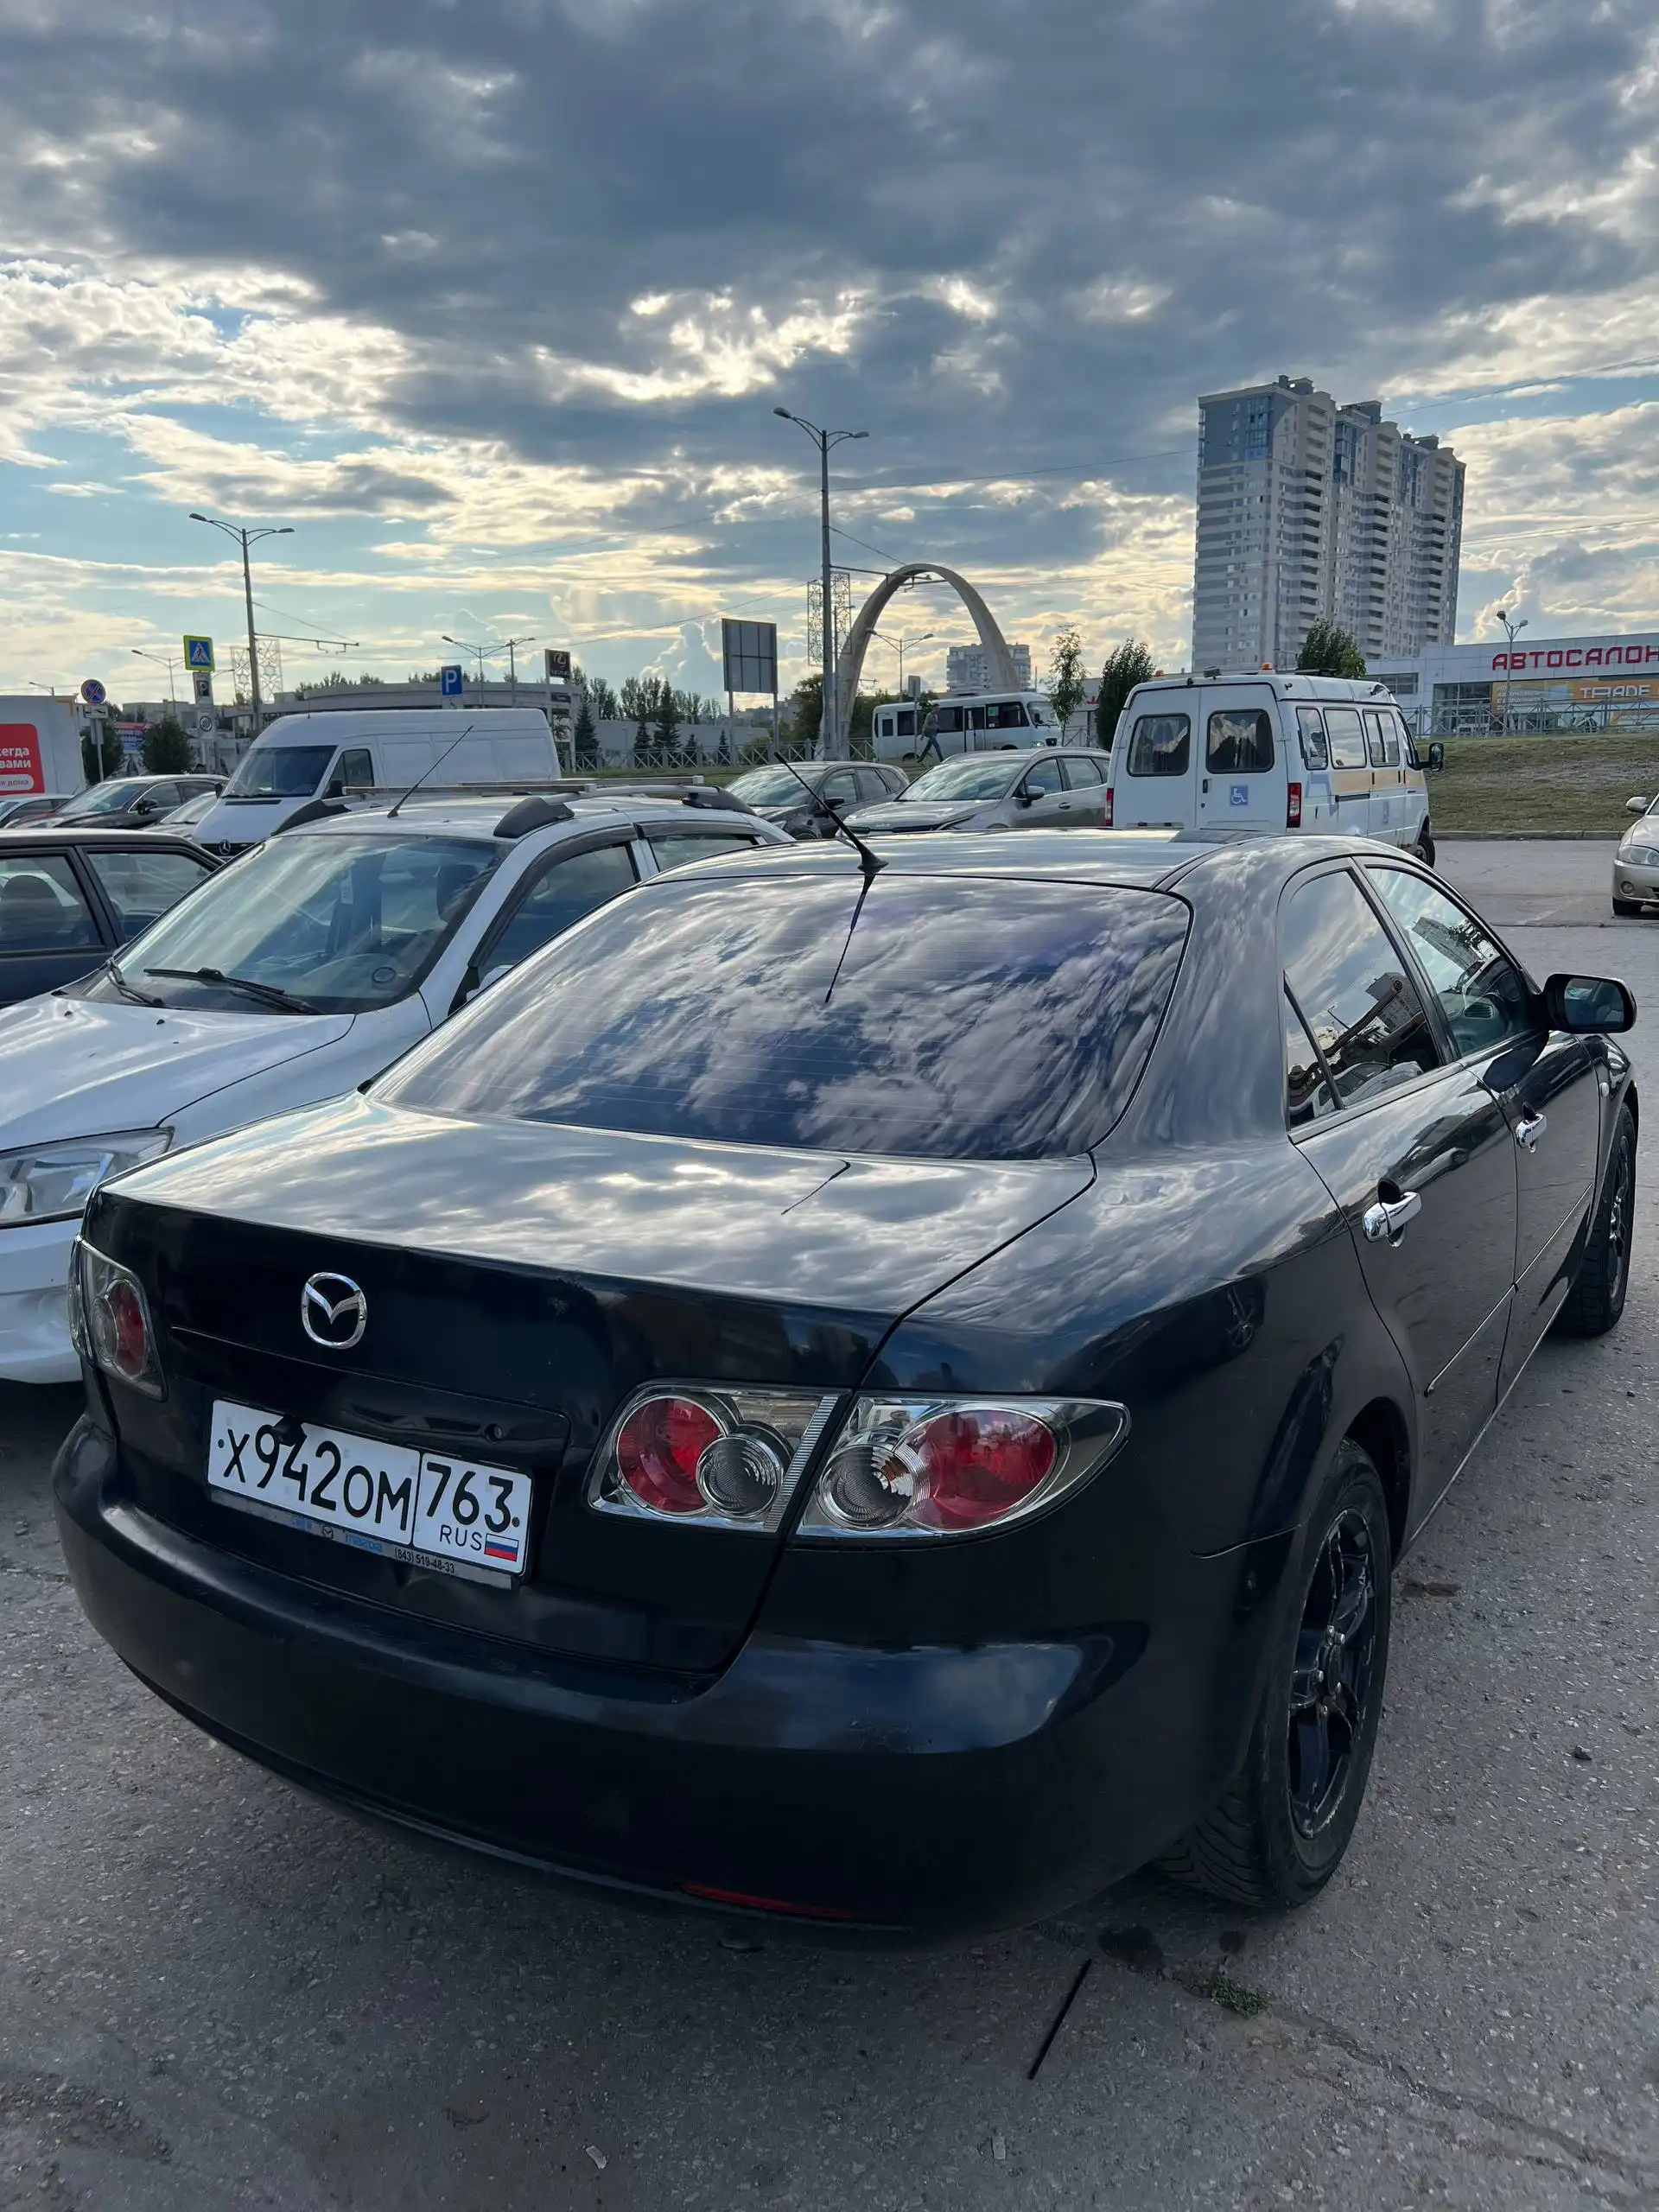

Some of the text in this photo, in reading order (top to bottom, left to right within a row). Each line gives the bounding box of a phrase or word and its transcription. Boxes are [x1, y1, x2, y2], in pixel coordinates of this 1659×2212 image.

[1492, 645, 1659, 671] АВТОСАЛОН
[446, 670, 457, 693] P
[1580, 684, 1650, 698] TRADE
[0, 747, 30, 757] егда
[426, 1461, 513, 1533] 763
[439, 1525, 483, 1550] RUS
